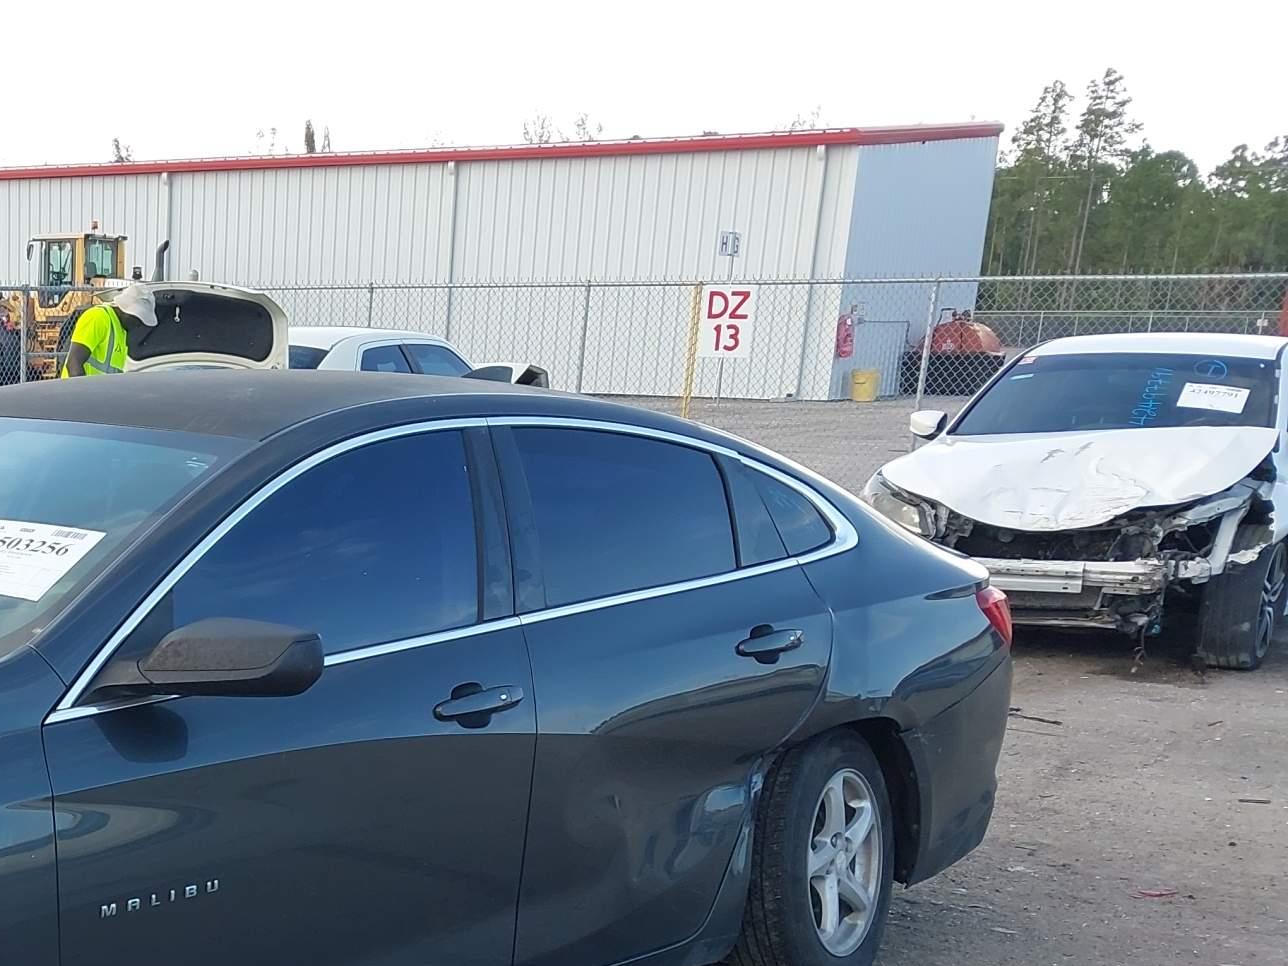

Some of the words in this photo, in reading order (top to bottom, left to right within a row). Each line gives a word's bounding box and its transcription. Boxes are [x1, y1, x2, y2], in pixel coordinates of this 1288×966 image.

[707, 290, 751, 319] DZ
[713, 323, 740, 351] 13
[99, 879, 220, 918] MALIBU
